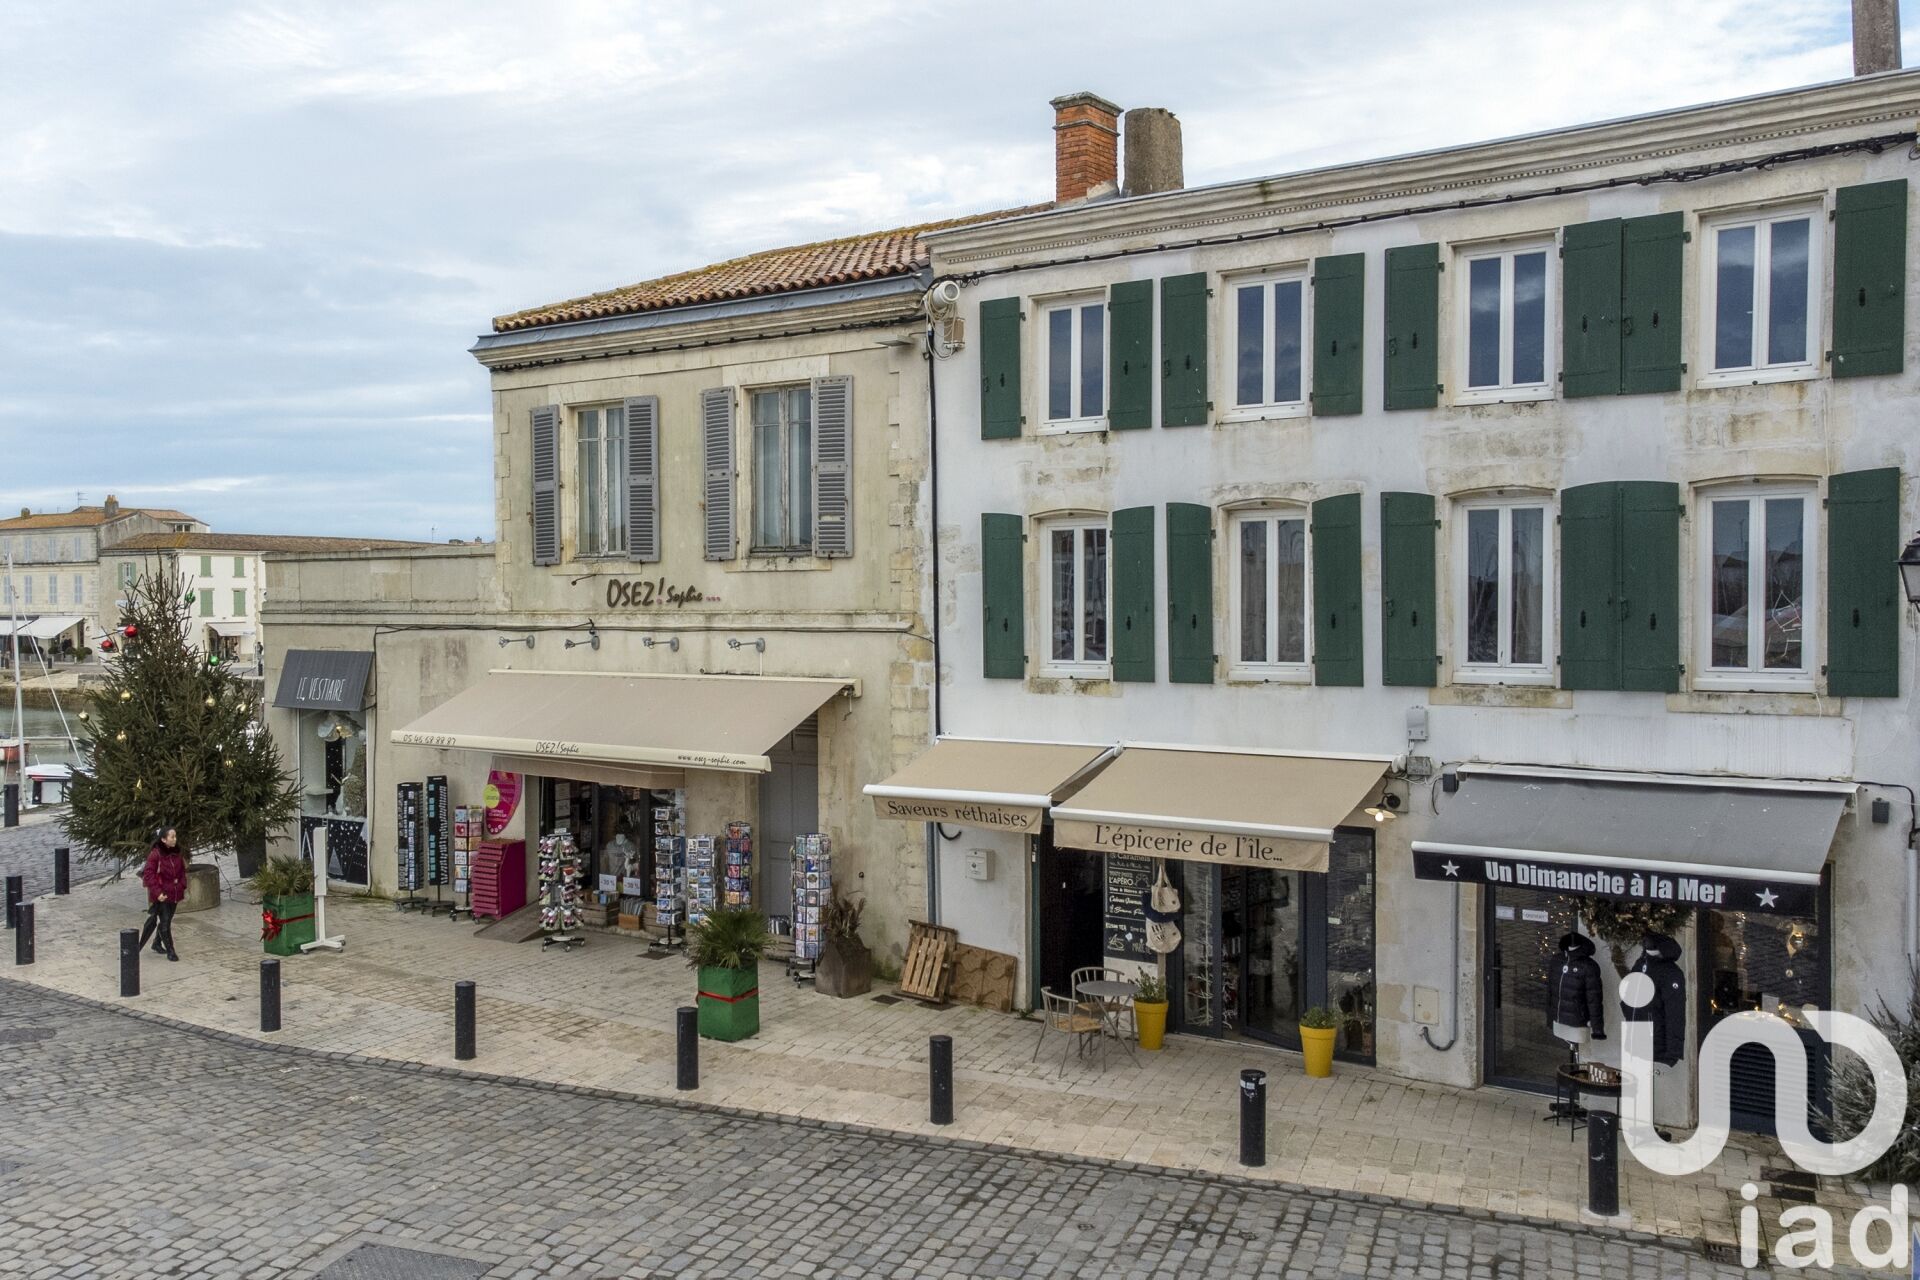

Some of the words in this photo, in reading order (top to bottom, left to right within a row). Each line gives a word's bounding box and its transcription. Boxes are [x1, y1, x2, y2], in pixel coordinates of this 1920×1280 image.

[606, 577, 664, 608] OSEZ!
[296, 677, 308, 701] LE
[309, 677, 347, 702] VESTIAIRE
[887, 800, 949, 818] Saveurs
[955, 804, 1028, 827] réthaises
[1095, 824, 1193, 853] L'épicerie
[1200, 834, 1227, 857] de
[1484, 860, 1513, 883] Un
[1515, 863, 1625, 895] Dimanche
[1630, 872, 1645, 897] à
[1650, 875, 1673, 900] la
[1678, 877, 1726, 904] Mer
